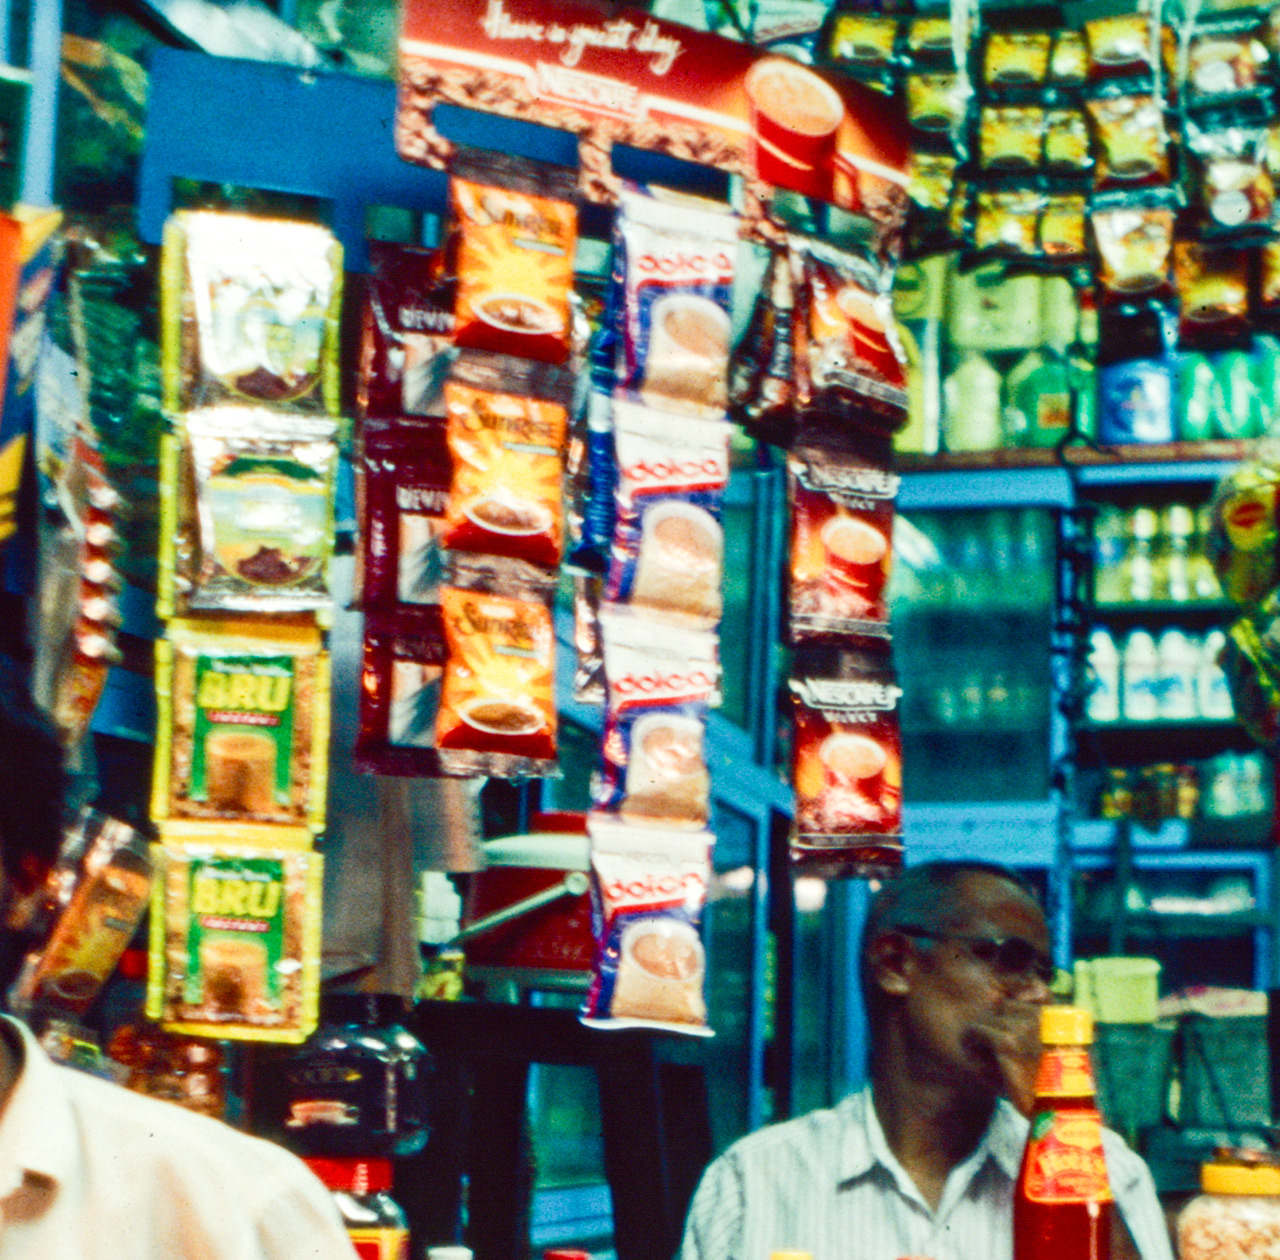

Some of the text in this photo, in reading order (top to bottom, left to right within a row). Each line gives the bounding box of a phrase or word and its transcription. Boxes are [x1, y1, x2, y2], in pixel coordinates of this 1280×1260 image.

[632, 18, 688, 76] day
[196, 669, 292, 712] BRU
[192, 877, 281, 918] BRU
